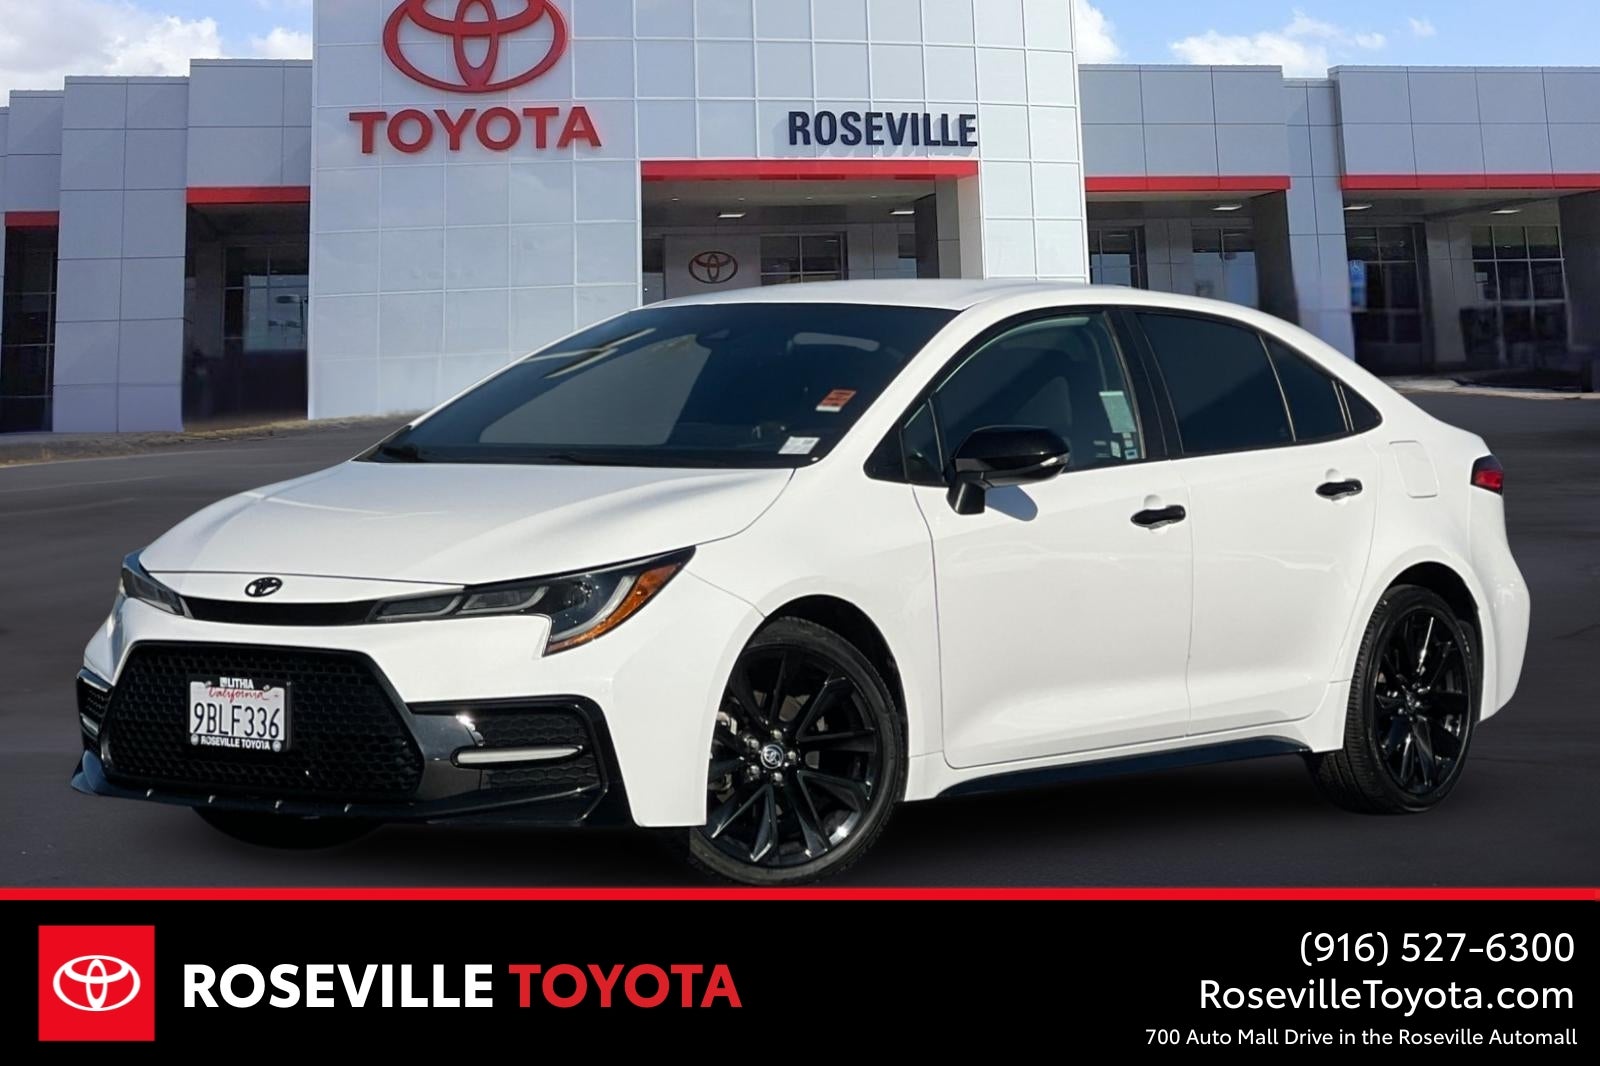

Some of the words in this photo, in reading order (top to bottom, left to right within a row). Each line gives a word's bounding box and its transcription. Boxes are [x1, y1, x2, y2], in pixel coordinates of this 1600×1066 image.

[349, 106, 602, 154] TOYOTA
[789, 111, 978, 147] ROSEVILLE
[208, 687, 264, 703] California
[227, 678, 254, 689] LITHIA
[193, 702, 280, 739] 9BLF336
[200, 735, 240, 748] ROSEVILLE
[241, 739, 271, 750] TOYOTA
